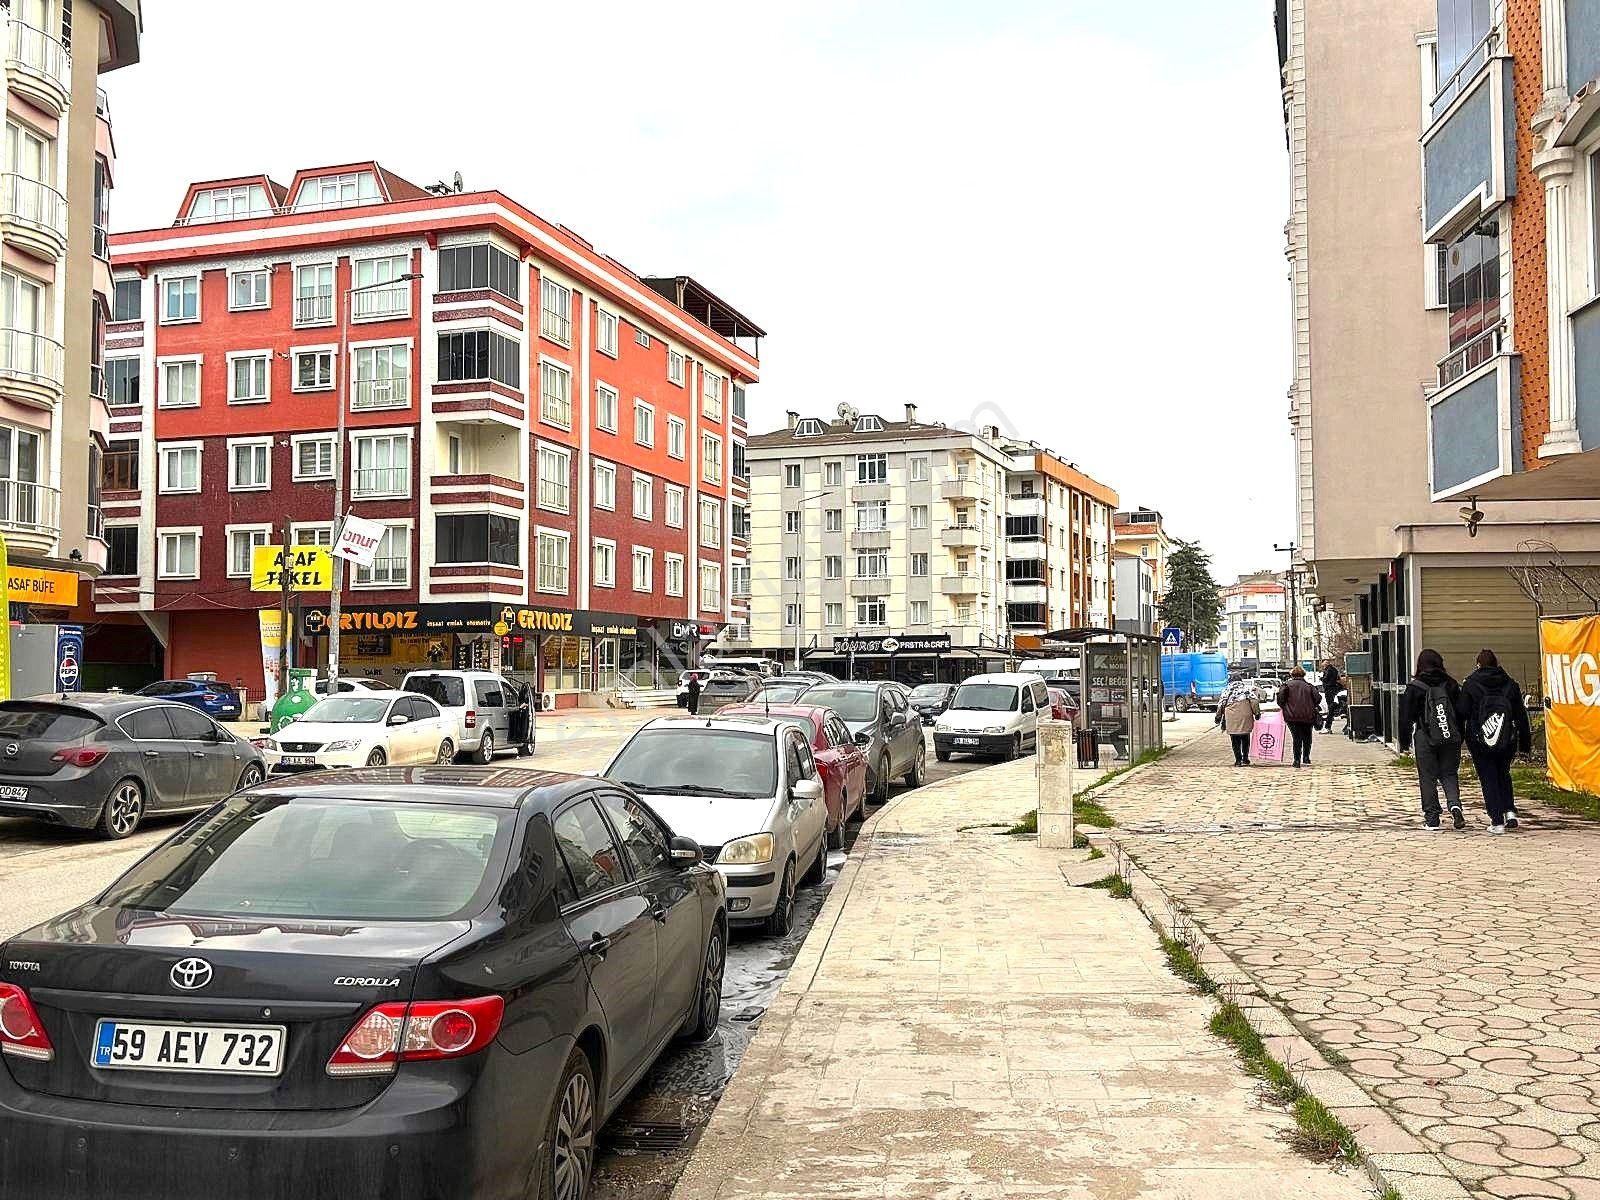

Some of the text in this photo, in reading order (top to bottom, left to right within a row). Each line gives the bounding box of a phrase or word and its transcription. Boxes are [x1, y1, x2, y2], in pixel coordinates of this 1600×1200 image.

[273, 551, 317, 566] AAF
[8, 577, 55, 594] ASAF BÜFE
[518, 609, 573, 631] ERYILDIZ
[1436, 703, 1451, 739] adidas
[1481, 712, 1501, 738] NIKE
[9, 960, 41, 972] TOYOTA
[333, 976, 401, 987] COROLLA
[100, 1028, 274, 1067] TR 59 AEV 732
